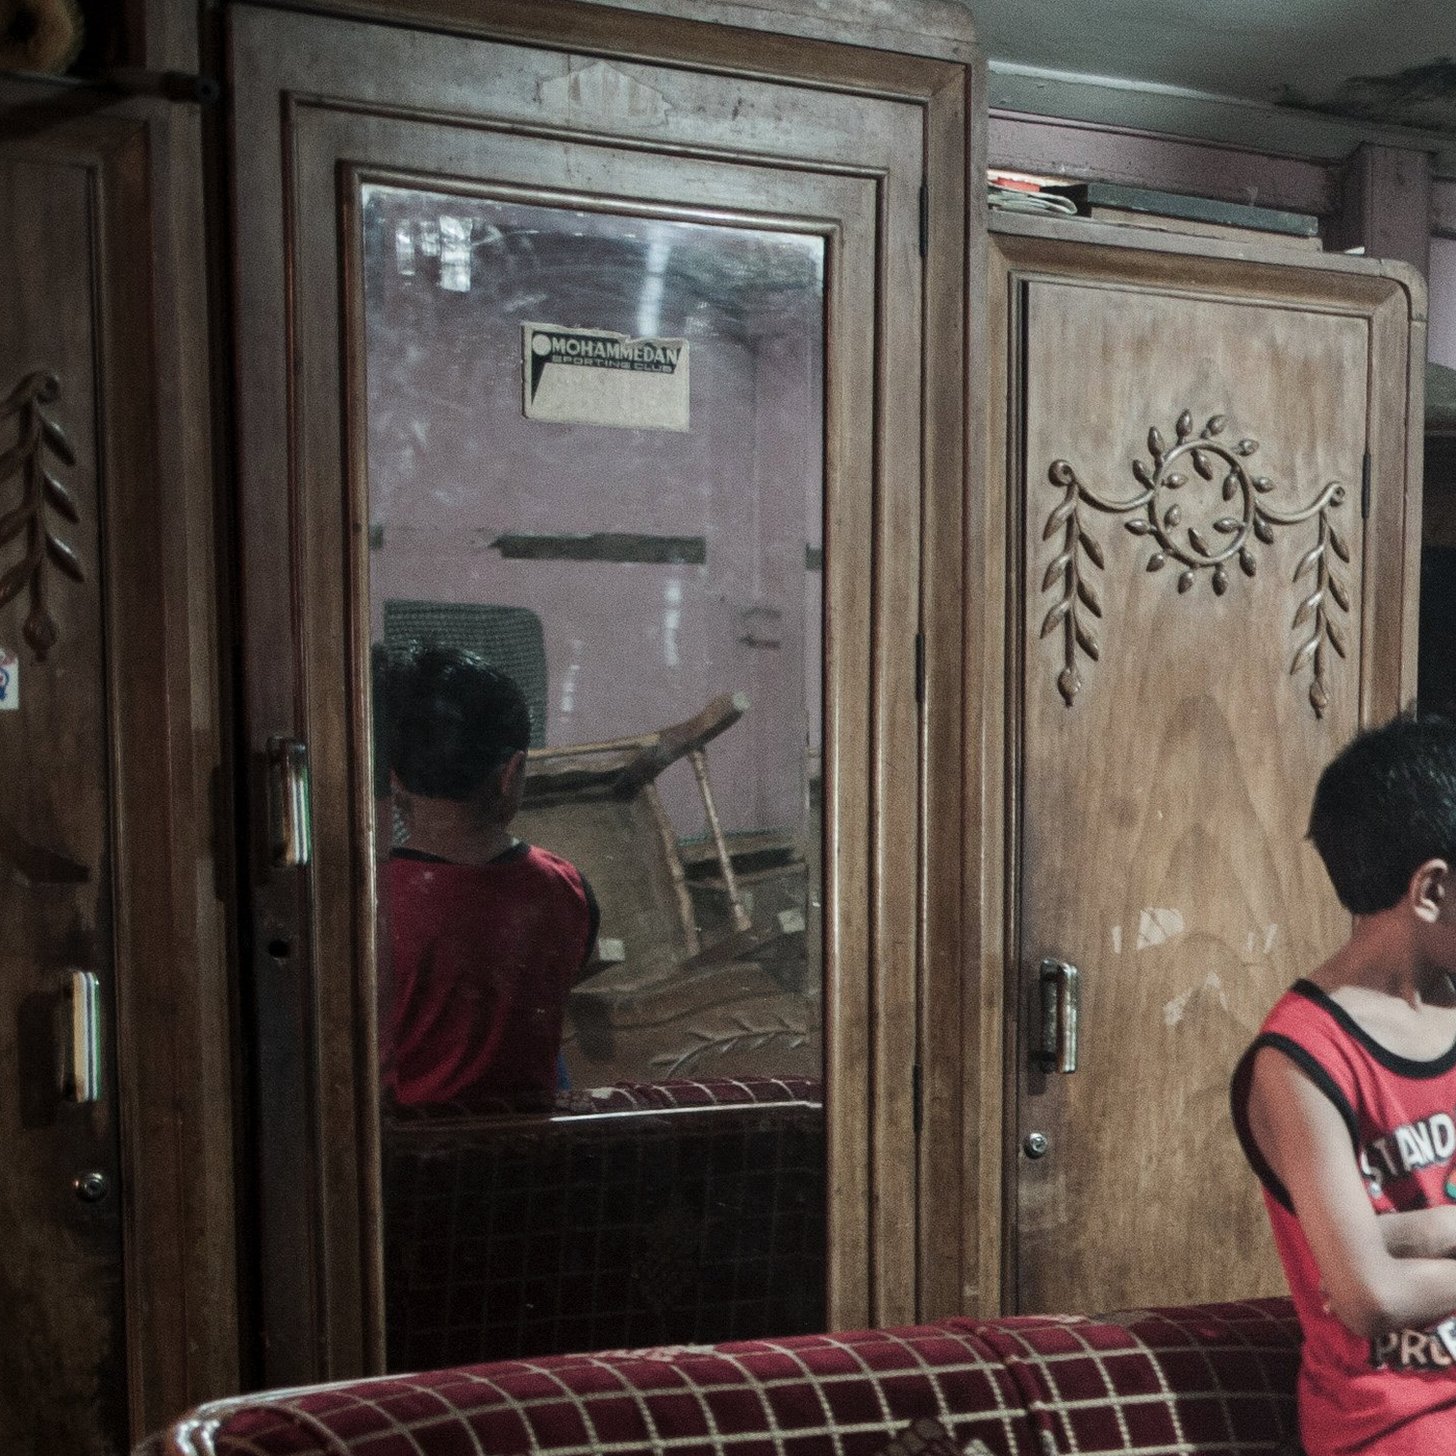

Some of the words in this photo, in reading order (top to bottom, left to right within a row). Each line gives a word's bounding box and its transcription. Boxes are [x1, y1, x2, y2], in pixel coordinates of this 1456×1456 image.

[552, 336, 678, 365] MOHAMMEDAN
[552, 355, 631, 370] SPORTING
[634, 362, 673, 373] CLUB
[1360, 1113, 1456, 1186] STAND
